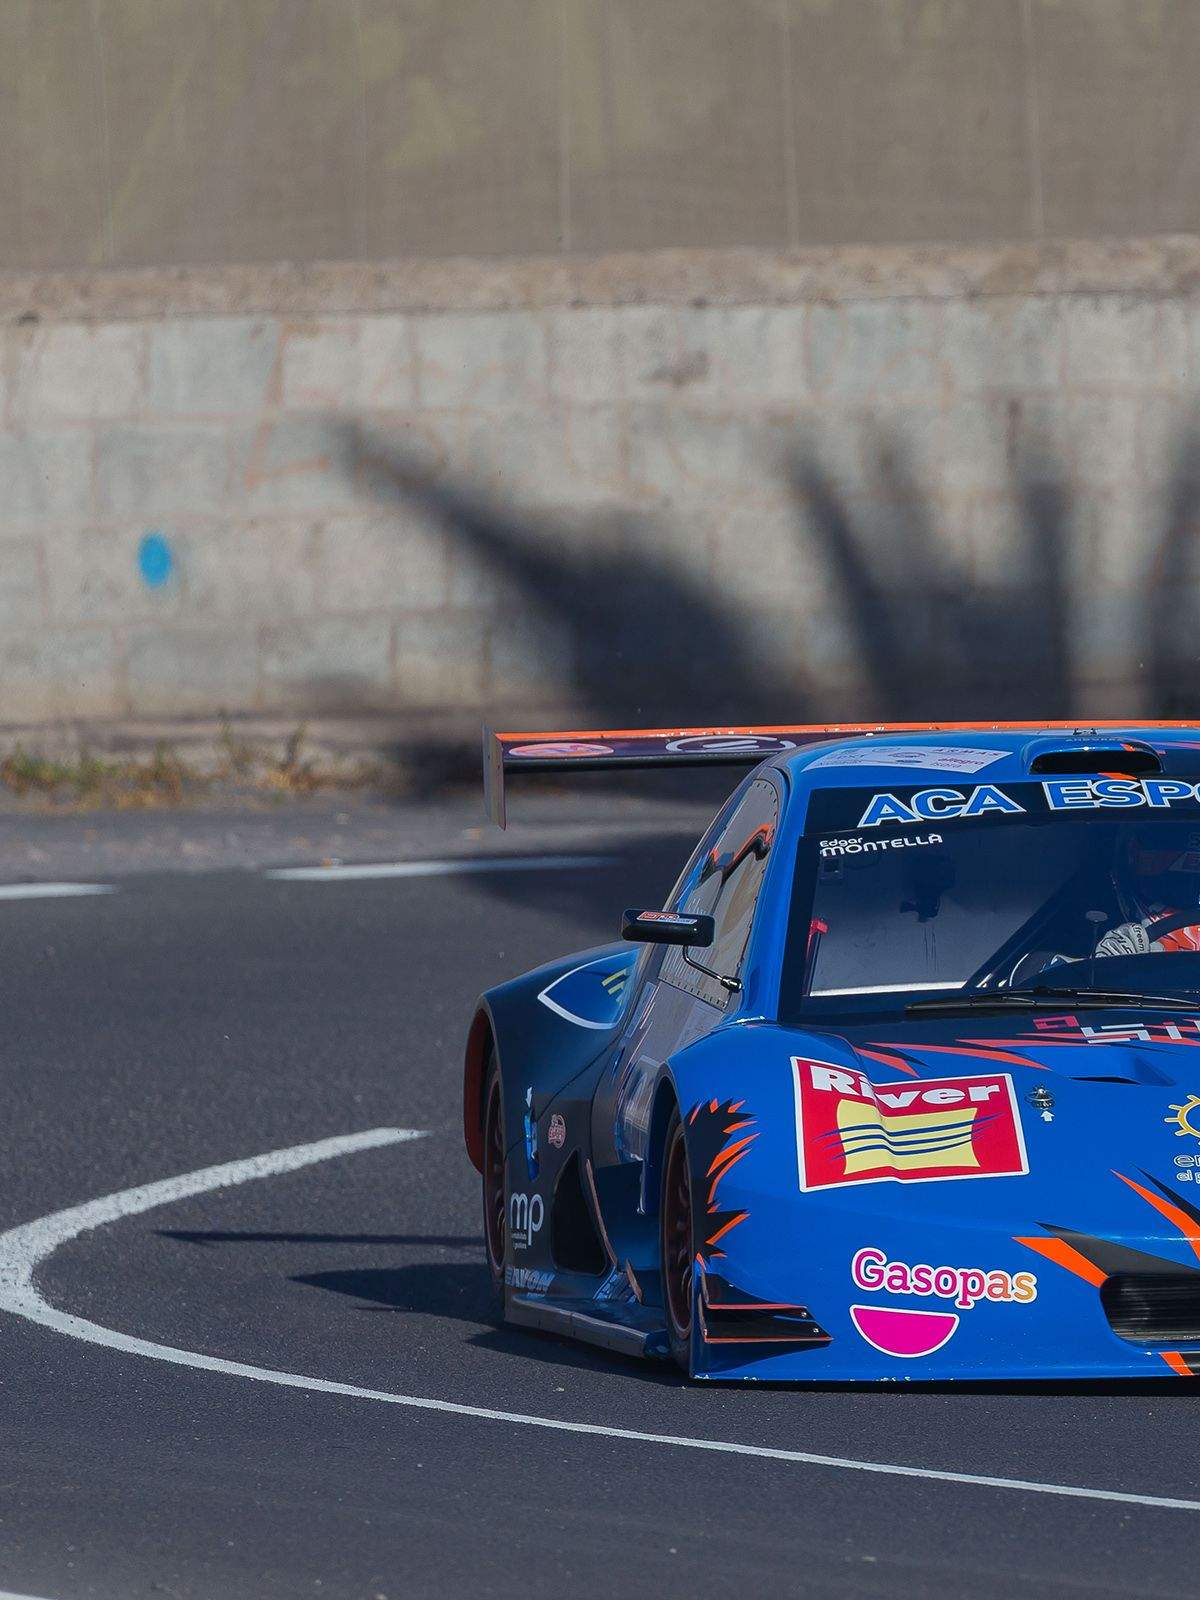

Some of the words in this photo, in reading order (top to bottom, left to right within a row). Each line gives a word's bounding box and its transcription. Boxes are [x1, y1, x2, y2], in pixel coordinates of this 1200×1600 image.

[857, 784, 1024, 828] ACA
[819, 836, 863, 850] Edgar
[810, 1064, 1002, 1108] River
[1177, 1170, 1193, 1181] el
[510, 1192, 544, 1246] mp
[851, 1247, 1038, 1309] Gasopas
